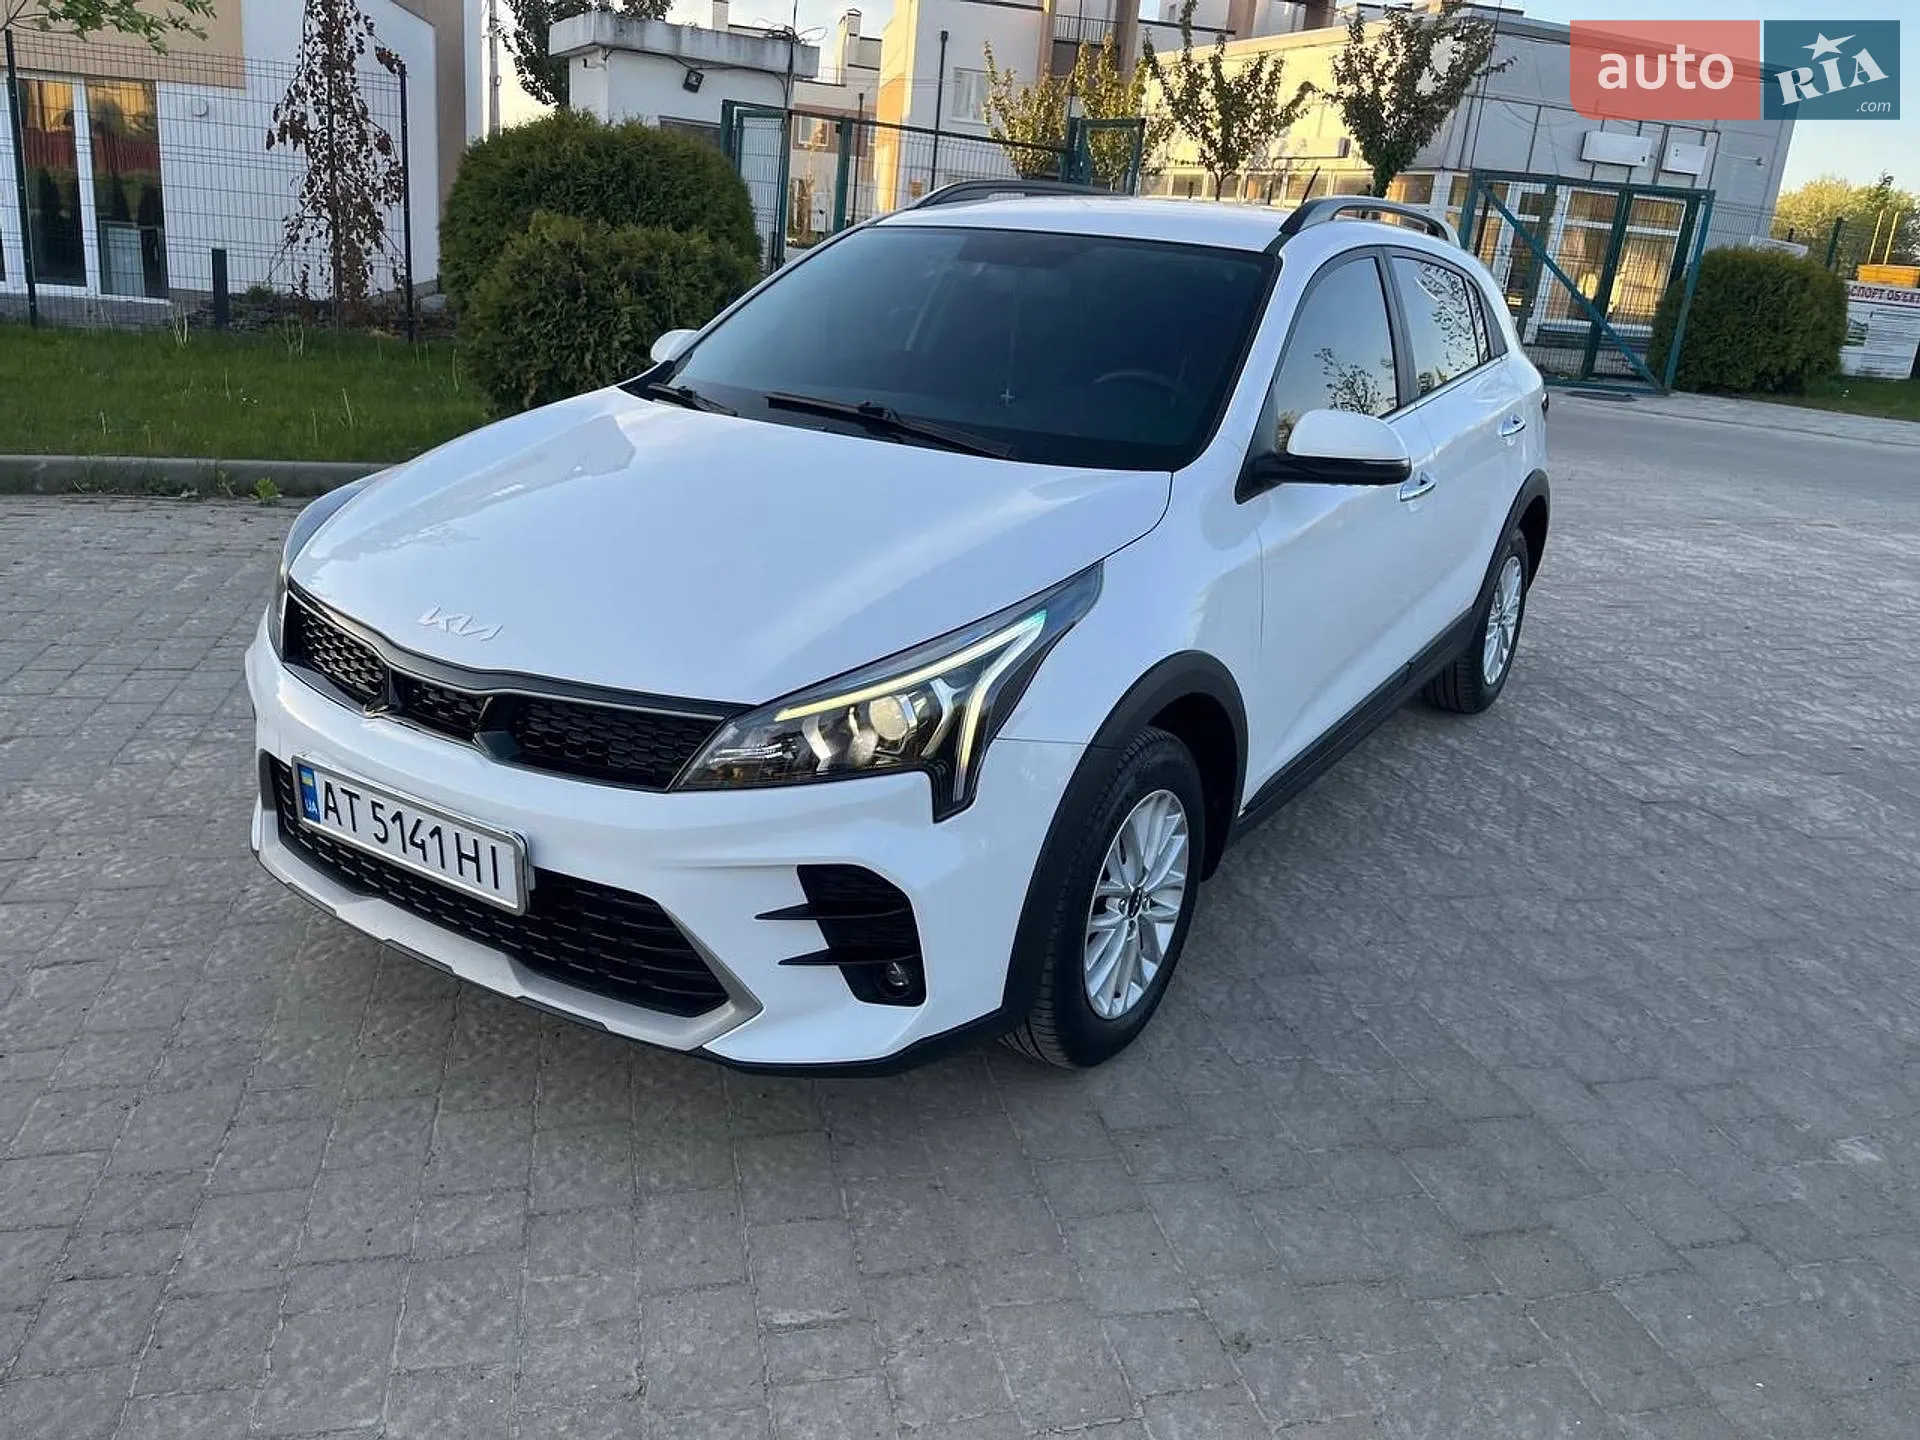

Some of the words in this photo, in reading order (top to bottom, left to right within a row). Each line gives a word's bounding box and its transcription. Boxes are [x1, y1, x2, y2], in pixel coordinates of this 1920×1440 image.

[1848, 284, 1886, 300] СПОРТ
[305, 800, 318, 813] UA
[324, 781, 360, 832] AT
[371, 800, 445, 869] 5141
[455, 832, 500, 890] HI
